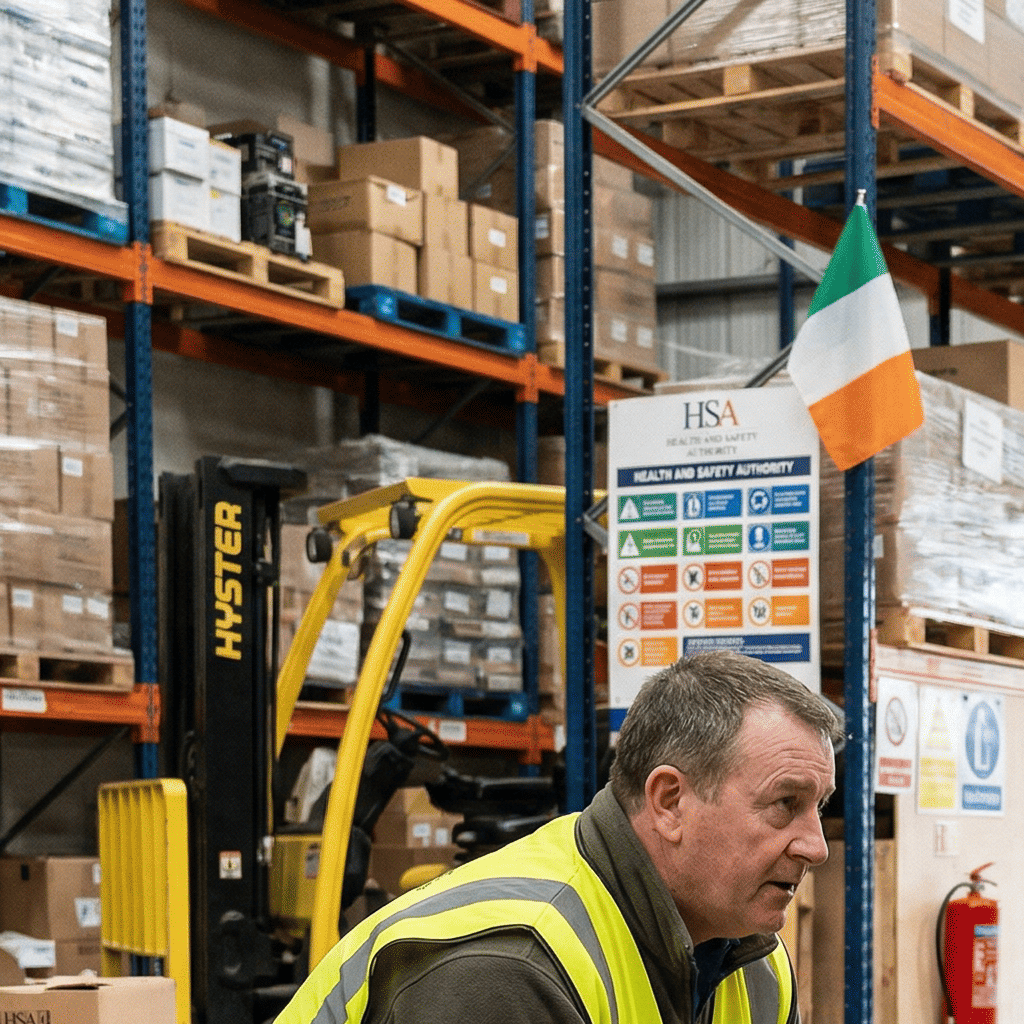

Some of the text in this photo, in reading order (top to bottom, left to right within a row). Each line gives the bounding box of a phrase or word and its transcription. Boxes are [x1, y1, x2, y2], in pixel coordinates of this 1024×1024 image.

[683, 399, 739, 430] HSA
[674, 467, 695, 480] AND
[696, 464, 736, 479] SAFETY
[735, 460, 794, 477] AUTHORITY
[214, 501, 243, 660] HYSTER
